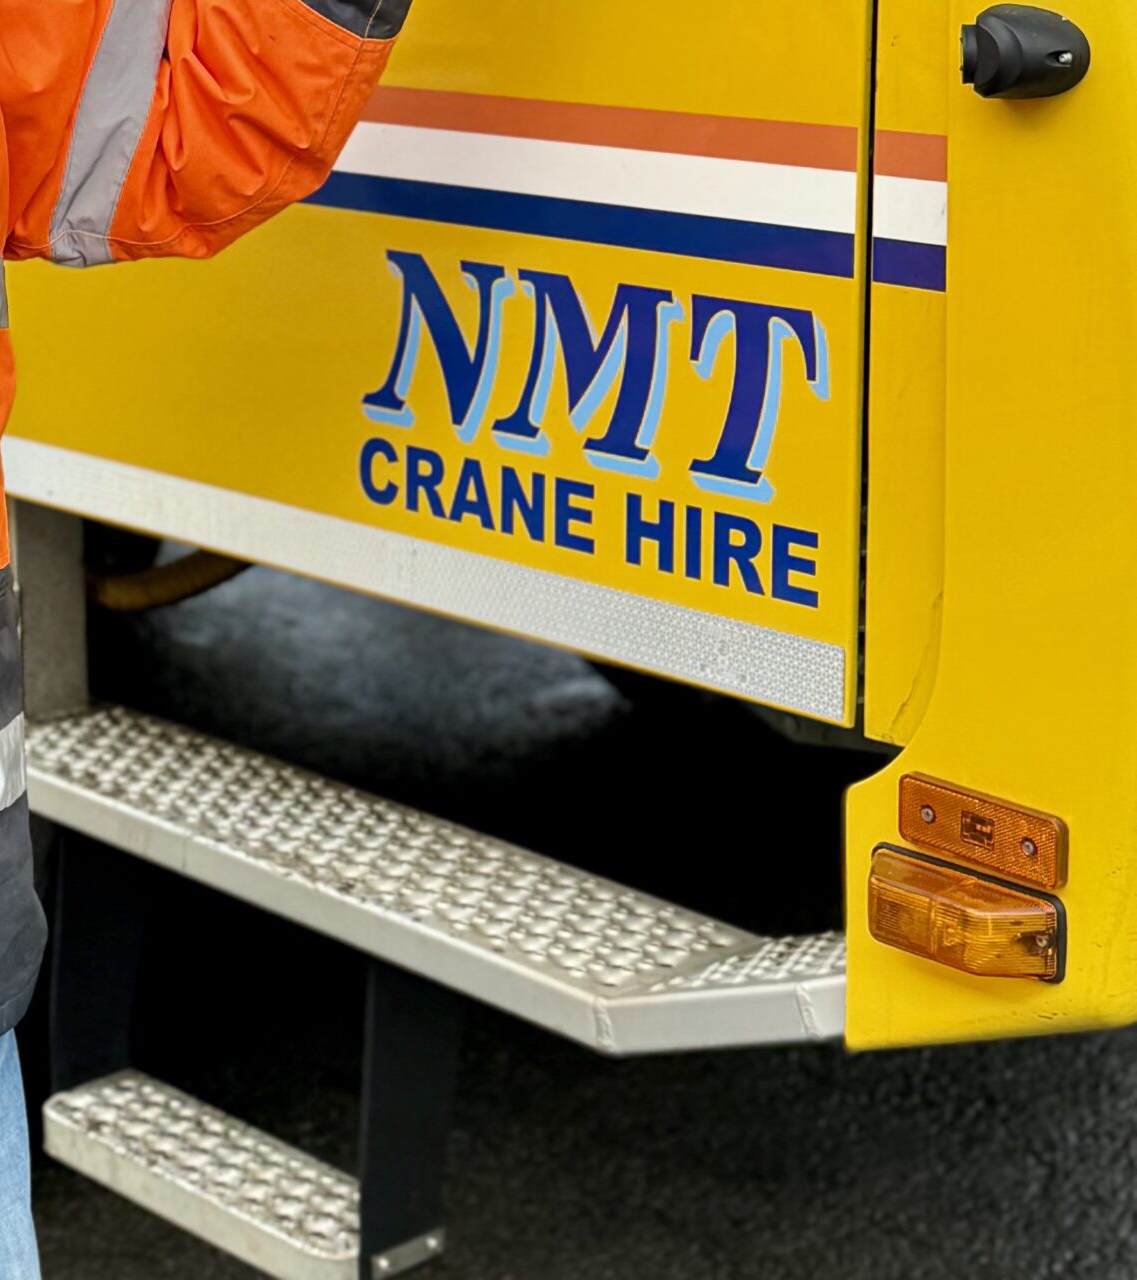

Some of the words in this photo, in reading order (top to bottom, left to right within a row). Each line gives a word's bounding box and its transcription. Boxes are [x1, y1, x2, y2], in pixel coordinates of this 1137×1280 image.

[361, 249, 829, 502] NMT
[359, 437, 595, 555] CRANE
[625, 492, 819, 609] HIRE
